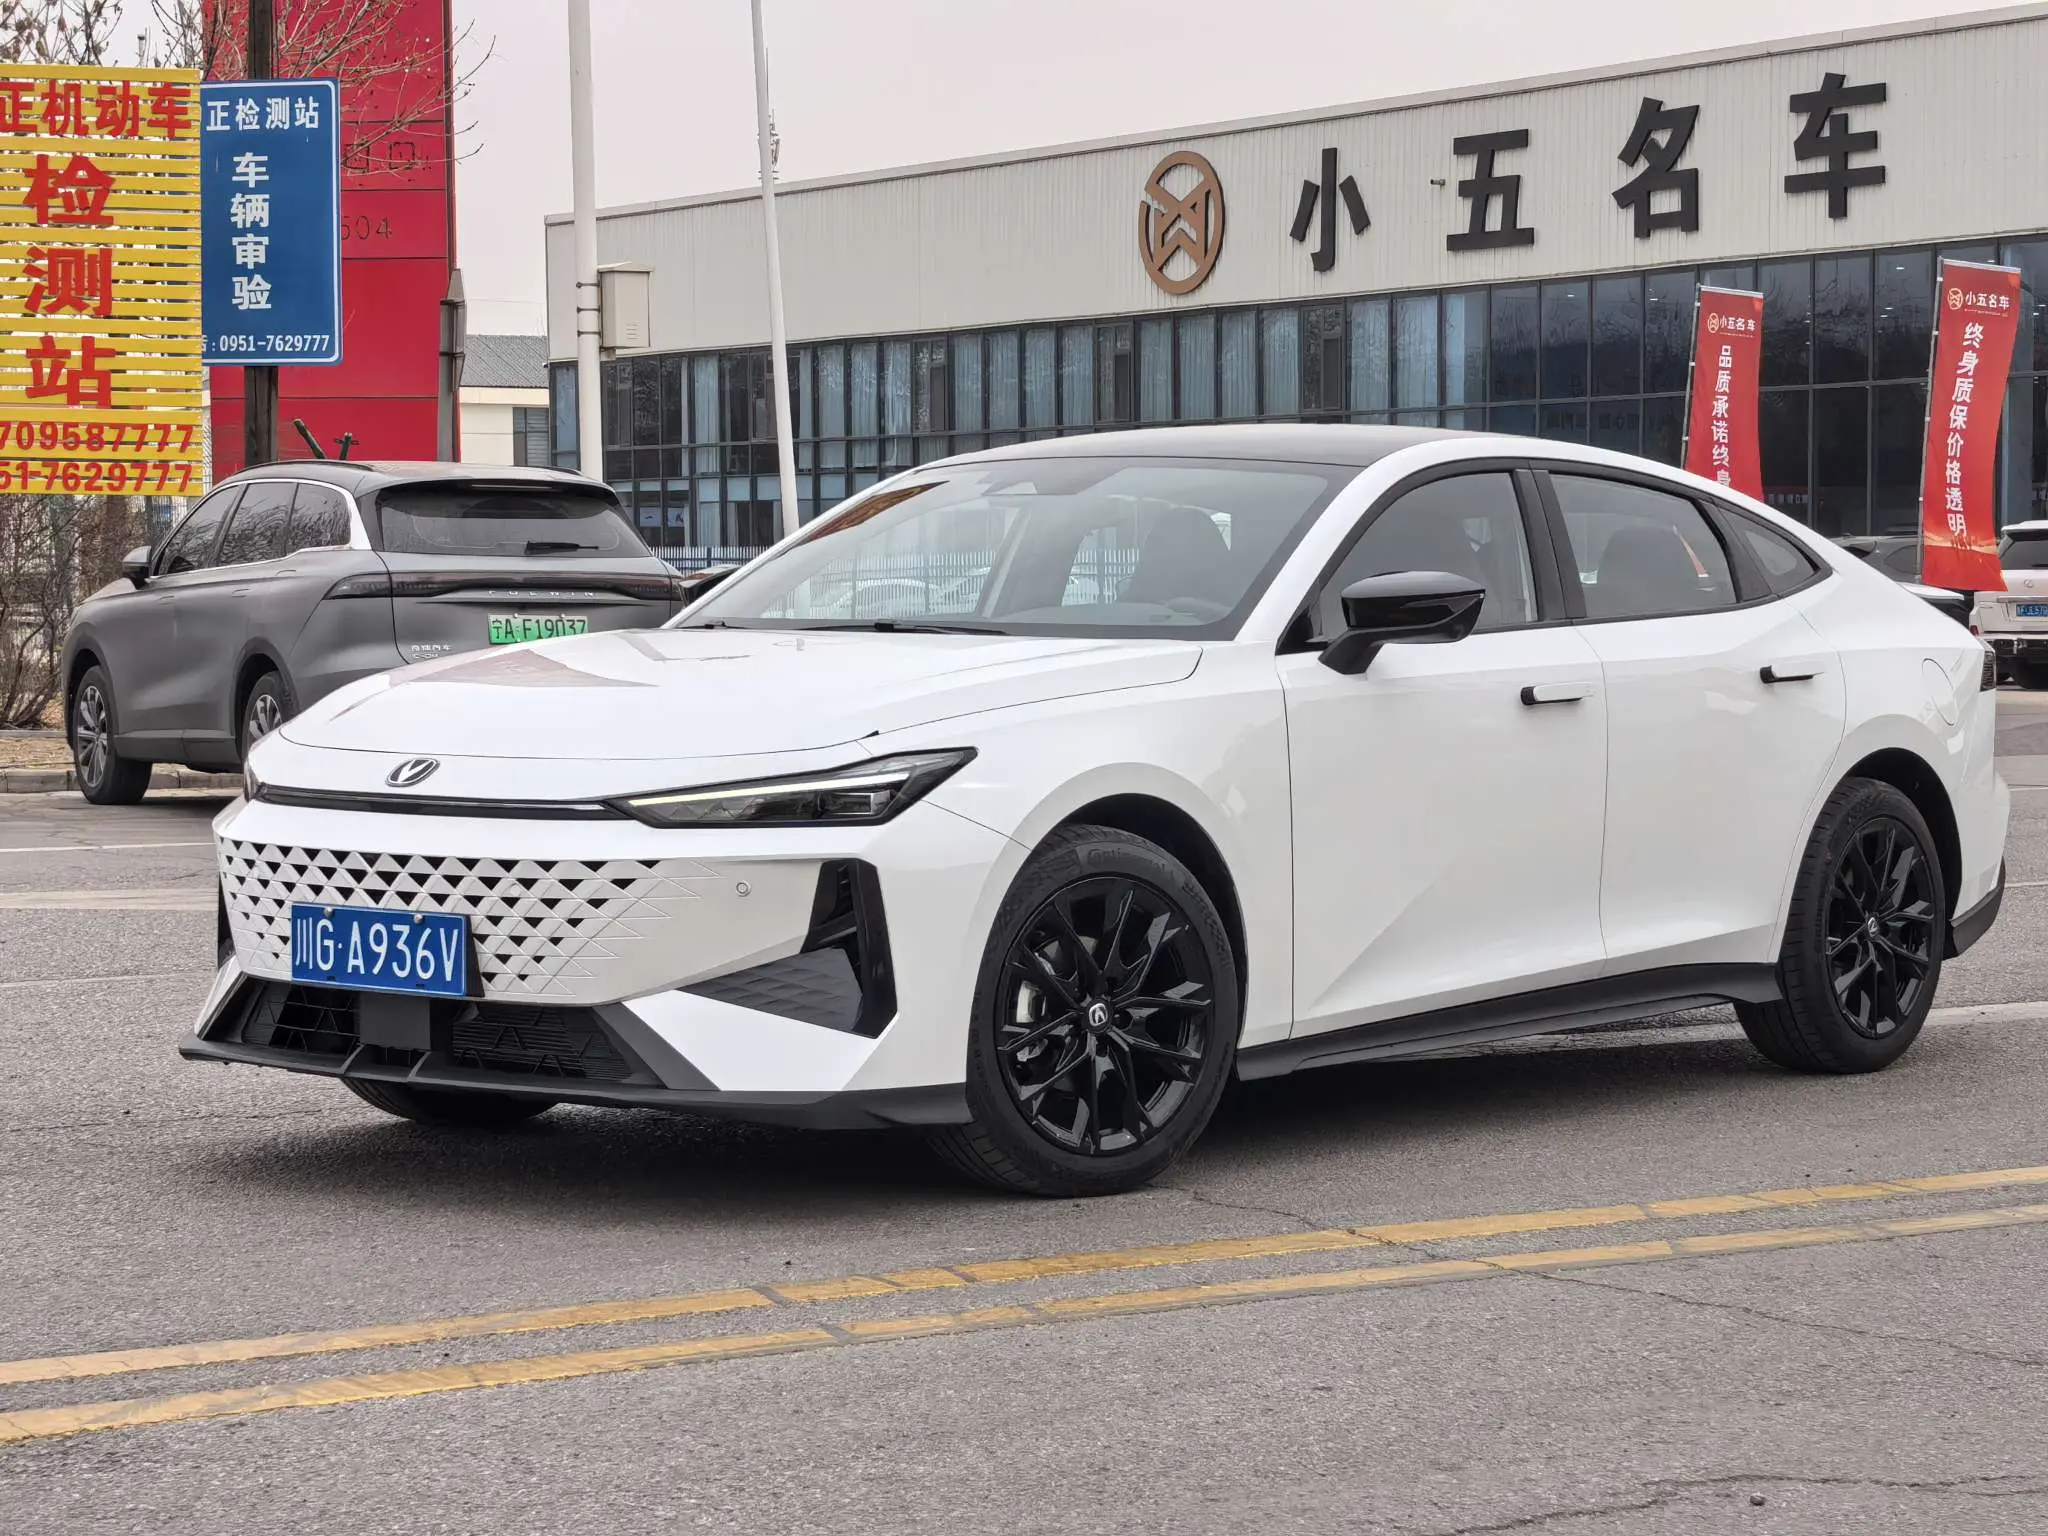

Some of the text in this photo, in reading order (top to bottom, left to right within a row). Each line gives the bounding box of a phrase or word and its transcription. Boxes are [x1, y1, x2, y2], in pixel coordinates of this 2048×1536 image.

[206, 96, 319, 131] 正检测站
[1290, 72, 1886, 272] 小五名车
[22, 154, 116, 408] 检测站
[230, 152, 271, 310] 车辆审验
[1965, 291, 2010, 310] 小五名车
[1720, 315, 1755, 331] 小五名车
[1945, 322, 1984, 536] 终身质保价格透明
